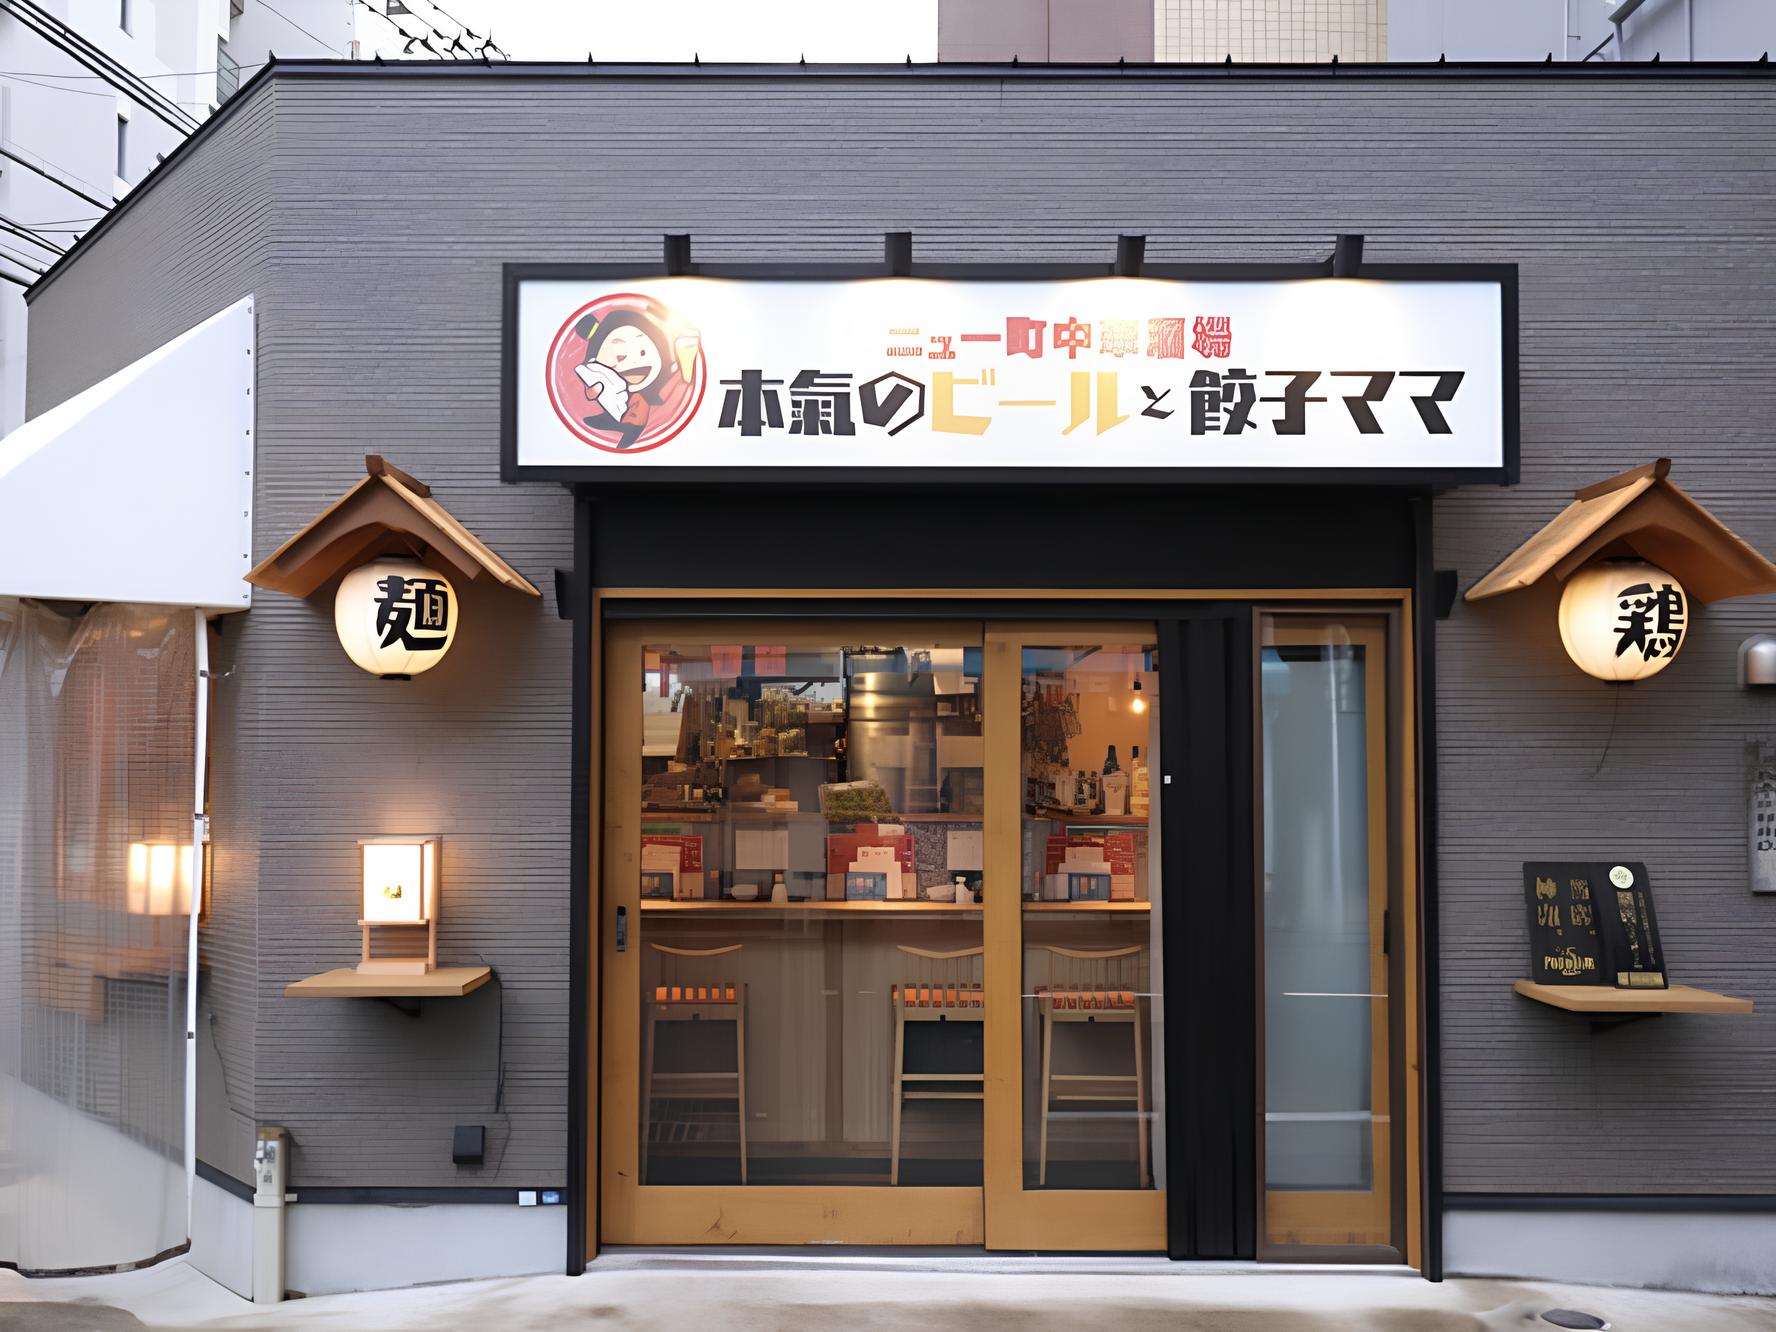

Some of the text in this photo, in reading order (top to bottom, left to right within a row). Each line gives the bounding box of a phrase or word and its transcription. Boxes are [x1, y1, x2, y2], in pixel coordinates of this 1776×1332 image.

[718, 368, 1465, 437] 本氣のビールと餃子ママ
